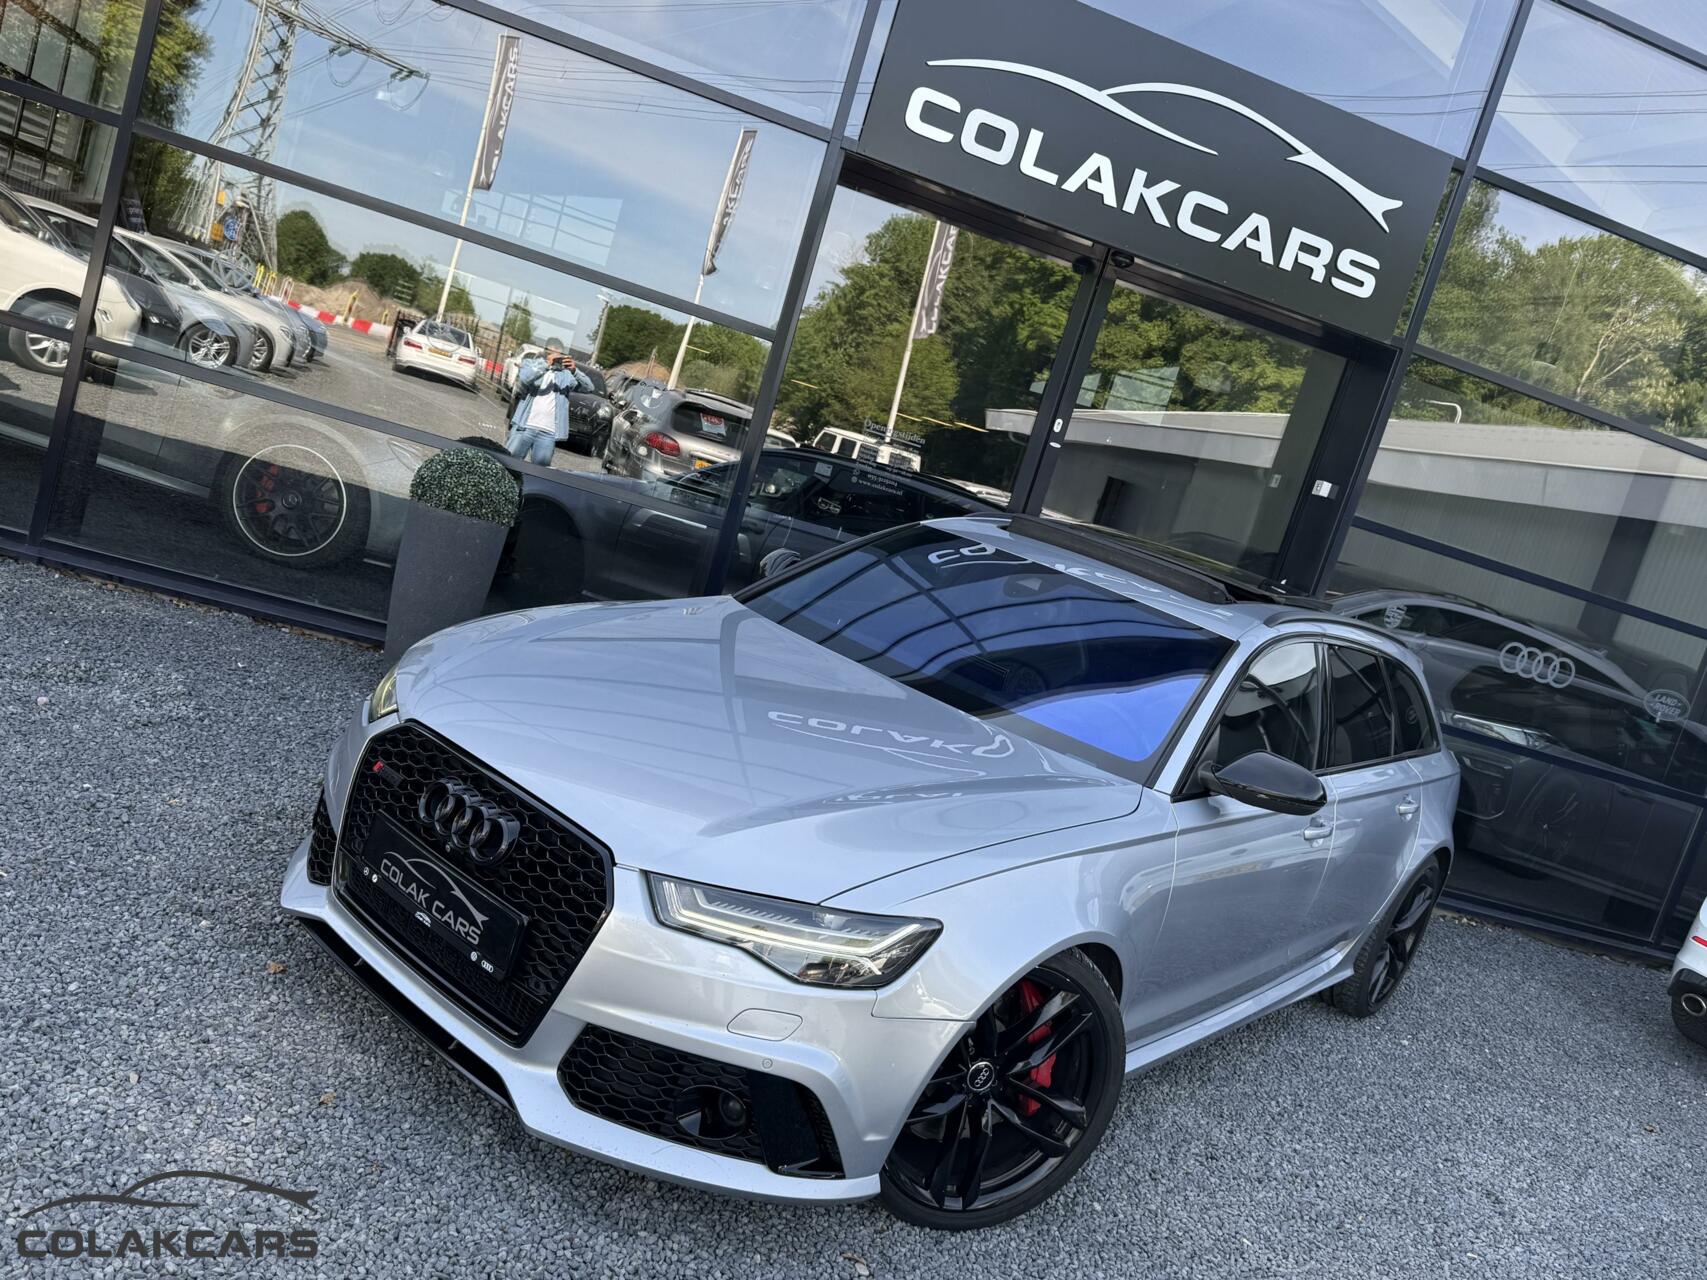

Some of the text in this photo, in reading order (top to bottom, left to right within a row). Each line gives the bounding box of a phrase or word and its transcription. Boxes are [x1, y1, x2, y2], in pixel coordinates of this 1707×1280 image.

[903, 86, 1381, 299] COLAKCARS
[864, 418, 926, 445] Opengstijden
[1653, 702, 1681, 716] ROVER
[1655, 693, 1678, 706] LAND
[380, 858, 482, 946] COLAK CARS
